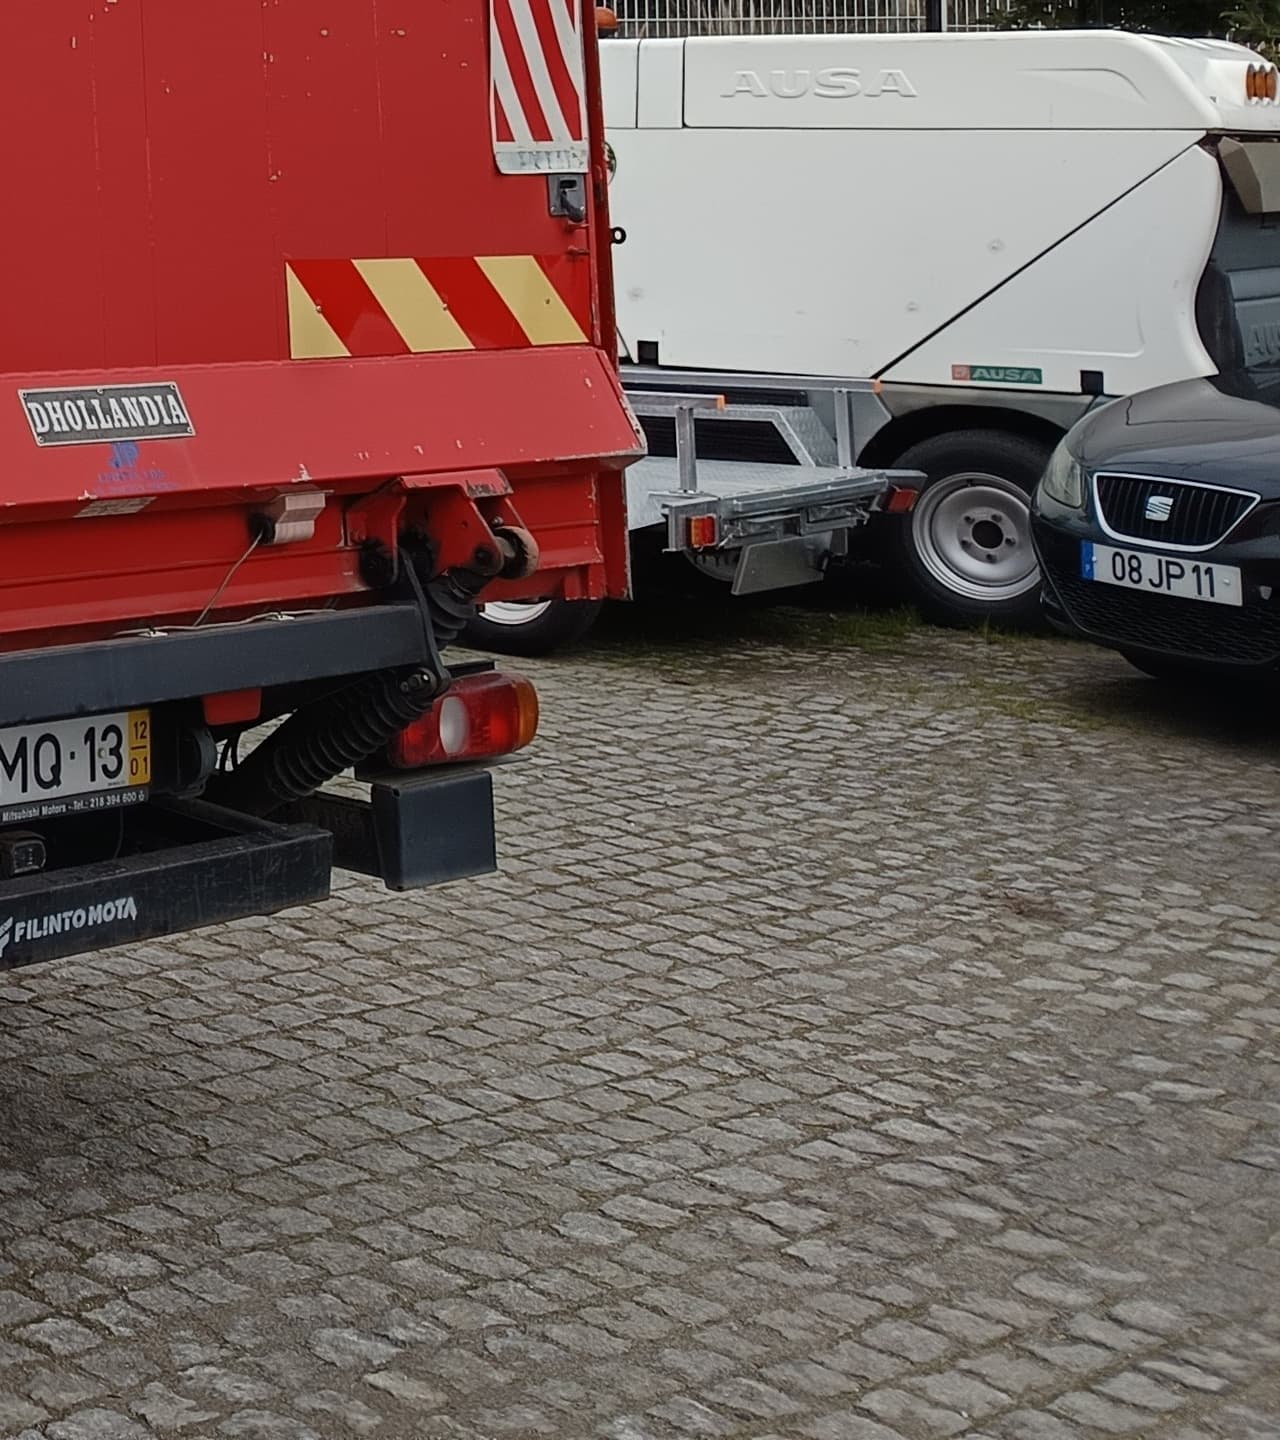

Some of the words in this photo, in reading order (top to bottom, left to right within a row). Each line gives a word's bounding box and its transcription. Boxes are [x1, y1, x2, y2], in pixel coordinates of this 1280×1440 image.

[719, 67, 919, 99] AUSA
[971, 367, 1040, 382] AUSA
[27, 393, 188, 433] DHOLLANDIA
[133, 720, 148, 740] 12
[130, 756, 148, 777] 01
[2, 806, 40, 822] Mitsubishi
[41, 803, 66, 817] Motors
[89, 795, 105, 809] 218
